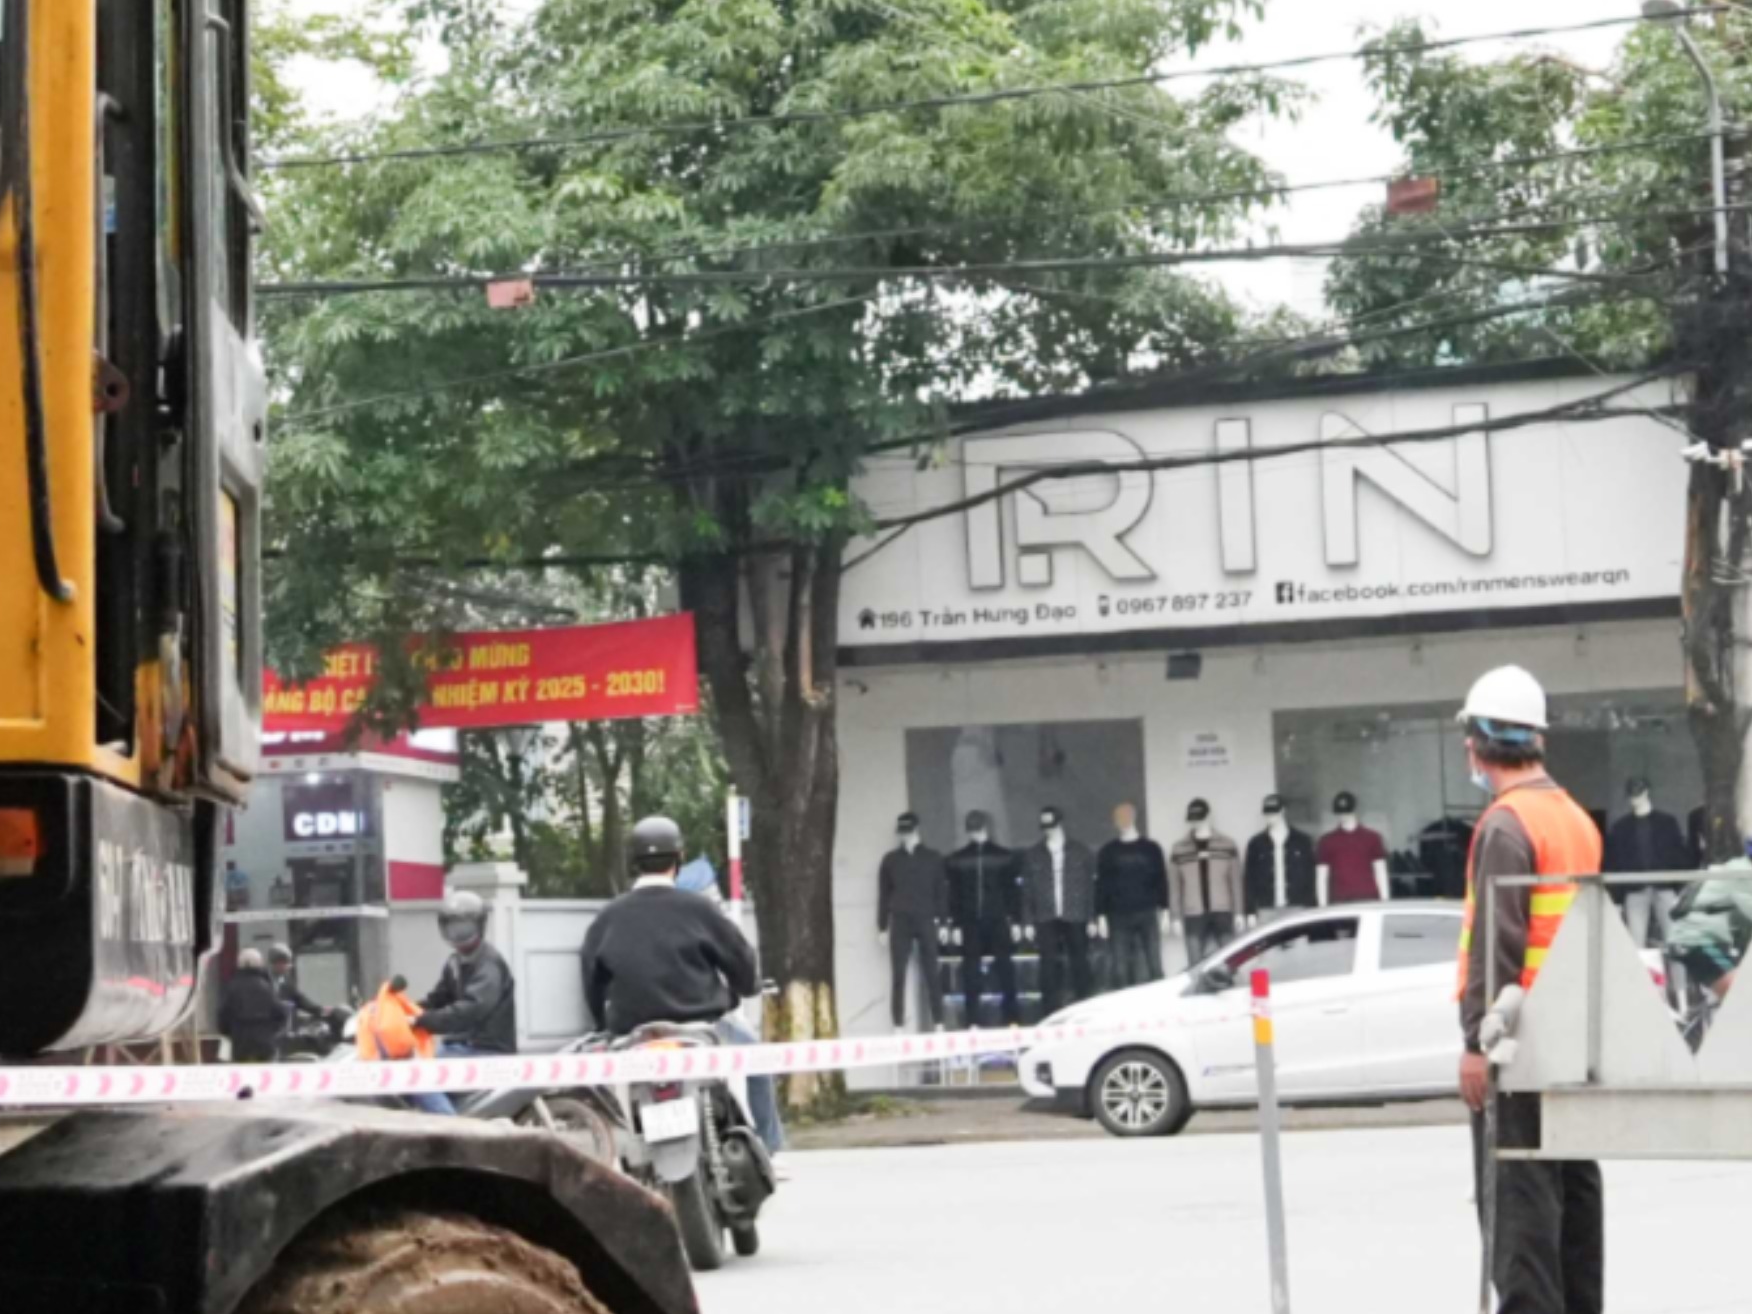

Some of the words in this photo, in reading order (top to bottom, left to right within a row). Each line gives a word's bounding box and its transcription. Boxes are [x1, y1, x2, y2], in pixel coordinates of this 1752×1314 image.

[962, 402, 1494, 592] RIN
[1116, 595, 1167, 616] 0967
[1171, 593, 1209, 613] 897
[1215, 590, 1254, 609] 237
[535, 675, 586, 702] 2025
[605, 669, 666, 697] 2030!
